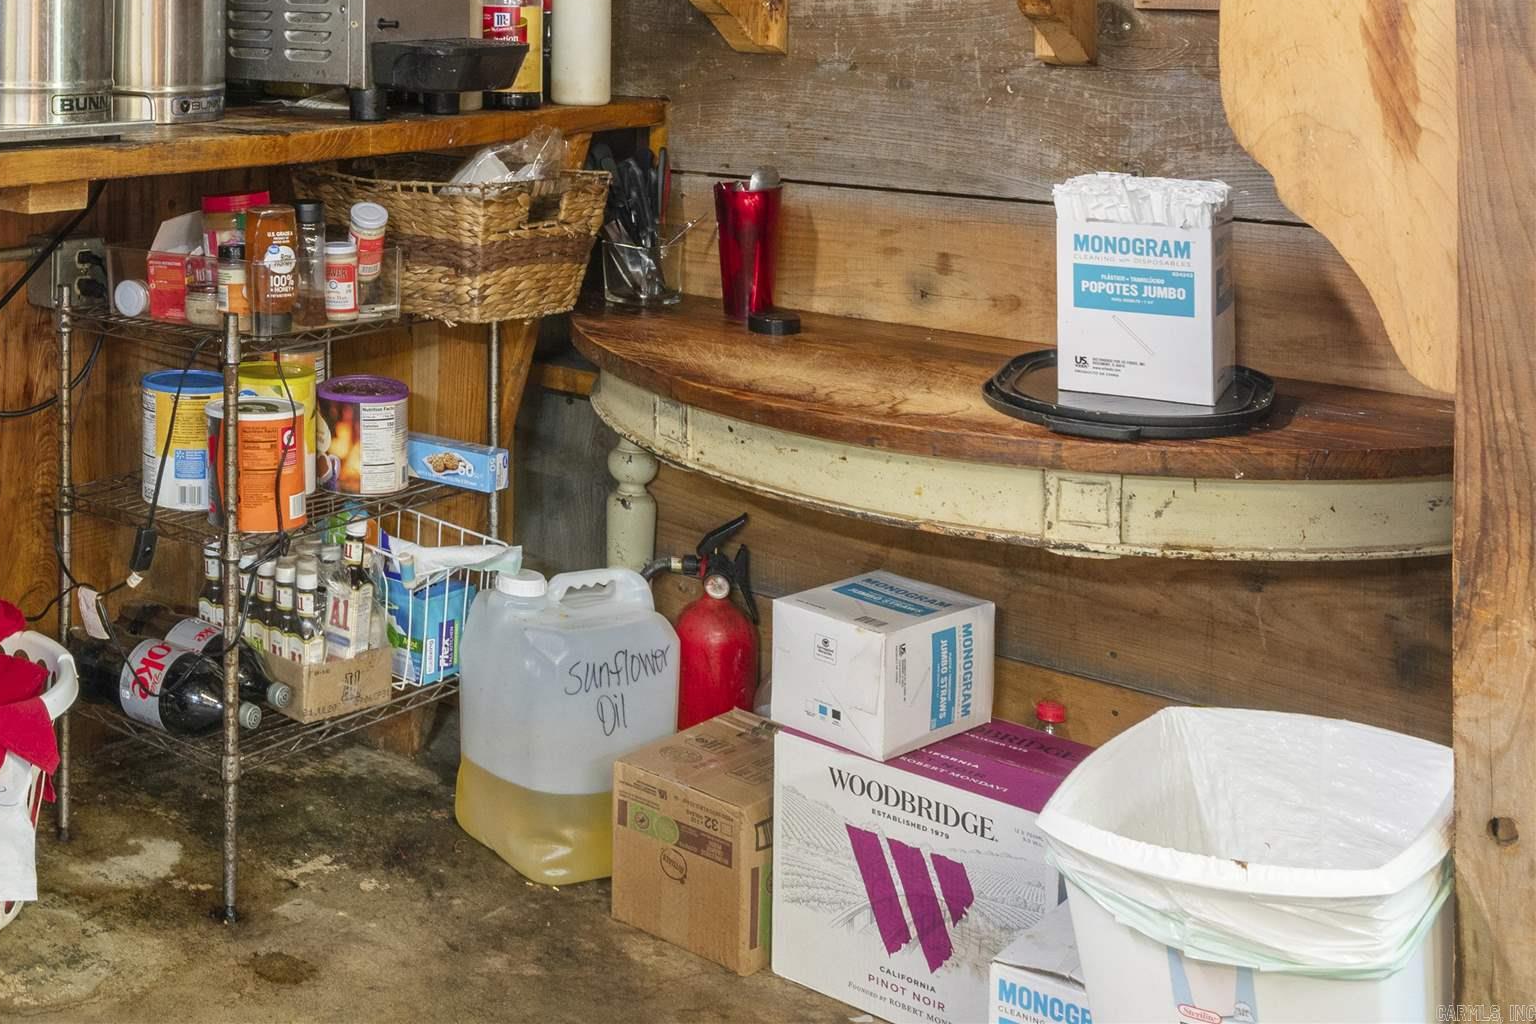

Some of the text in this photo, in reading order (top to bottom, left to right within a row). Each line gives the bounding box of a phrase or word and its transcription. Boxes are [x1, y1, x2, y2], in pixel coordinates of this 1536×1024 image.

[60, 95, 112, 112] BUNN
[1073, 233, 1191, 259] MONOGRAM
[1074, 254, 1115, 263] CLEANING
[270, 275, 294, 287] 100%
[1081, 280, 1138, 297] POPOTES
[1142, 284, 1186, 301] JUMBO
[863, 577, 952, 608] MONOGRAM
[131, 644, 172, 700] oke
[564, 644, 671, 696] Sunflower
[939, 639, 948, 720] JUMBO STRAWS
[961, 622, 973, 718] MONOGRAM
[596, 694, 628, 737] Oil
[920, 749, 980, 769] LIFORNIA
[900, 756, 1009, 793] ROBERT MONDAVI
[704, 815, 719, 832] 32
[872, 808, 950, 840] ESTABLISHED 1979
[868, 974, 946, 1012] PINOT NOIR
[879, 966, 937, 993] CALIFORNIA
[889, 998, 924, 1018] ROBERT
